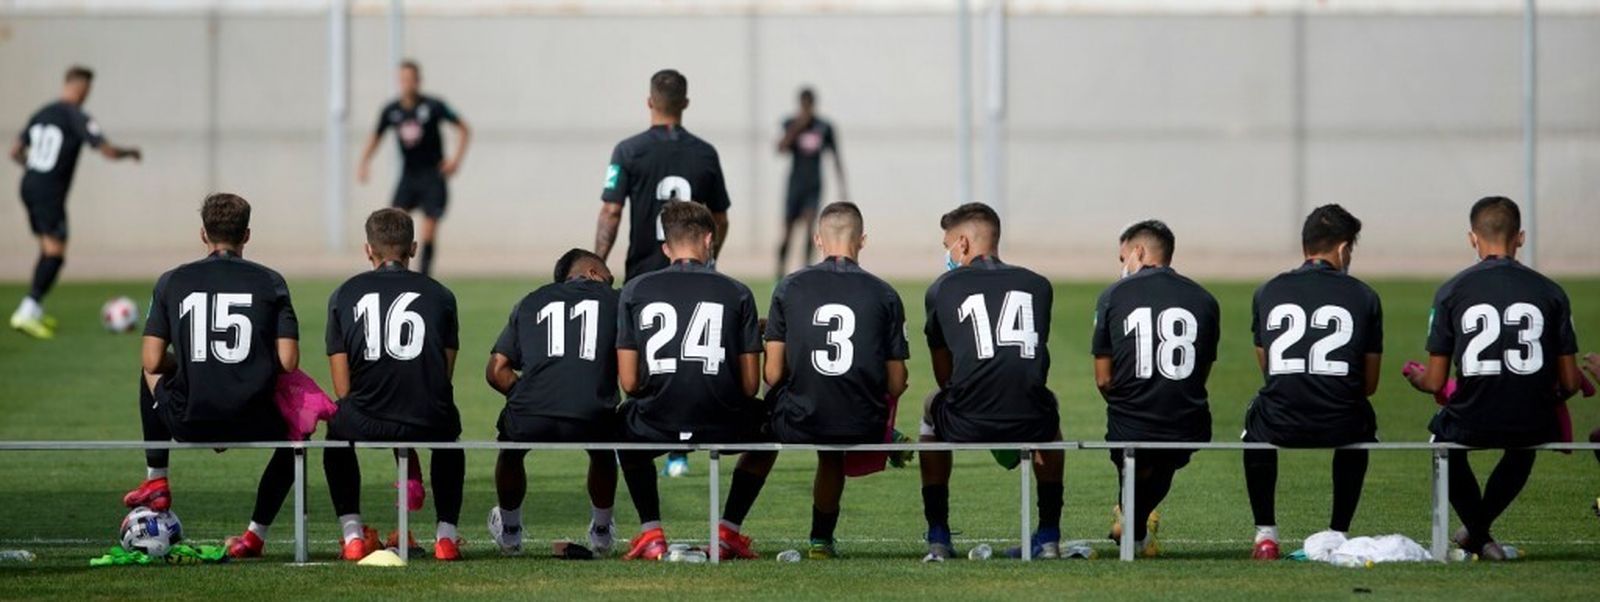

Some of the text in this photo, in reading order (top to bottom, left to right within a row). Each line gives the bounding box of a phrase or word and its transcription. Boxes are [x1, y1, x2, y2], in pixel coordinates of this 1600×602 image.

[27, 123, 63, 172] 10
[179, 292, 253, 364] 15
[353, 292, 426, 361] 16
[537, 300, 600, 361] 11
[640, 302, 726, 375] 24
[811, 303, 856, 376] 3
[958, 290, 1039, 360] 14
[1123, 307, 1198, 380] 18
[1266, 303, 1354, 376] 22
[1461, 302, 1545, 377] 23
